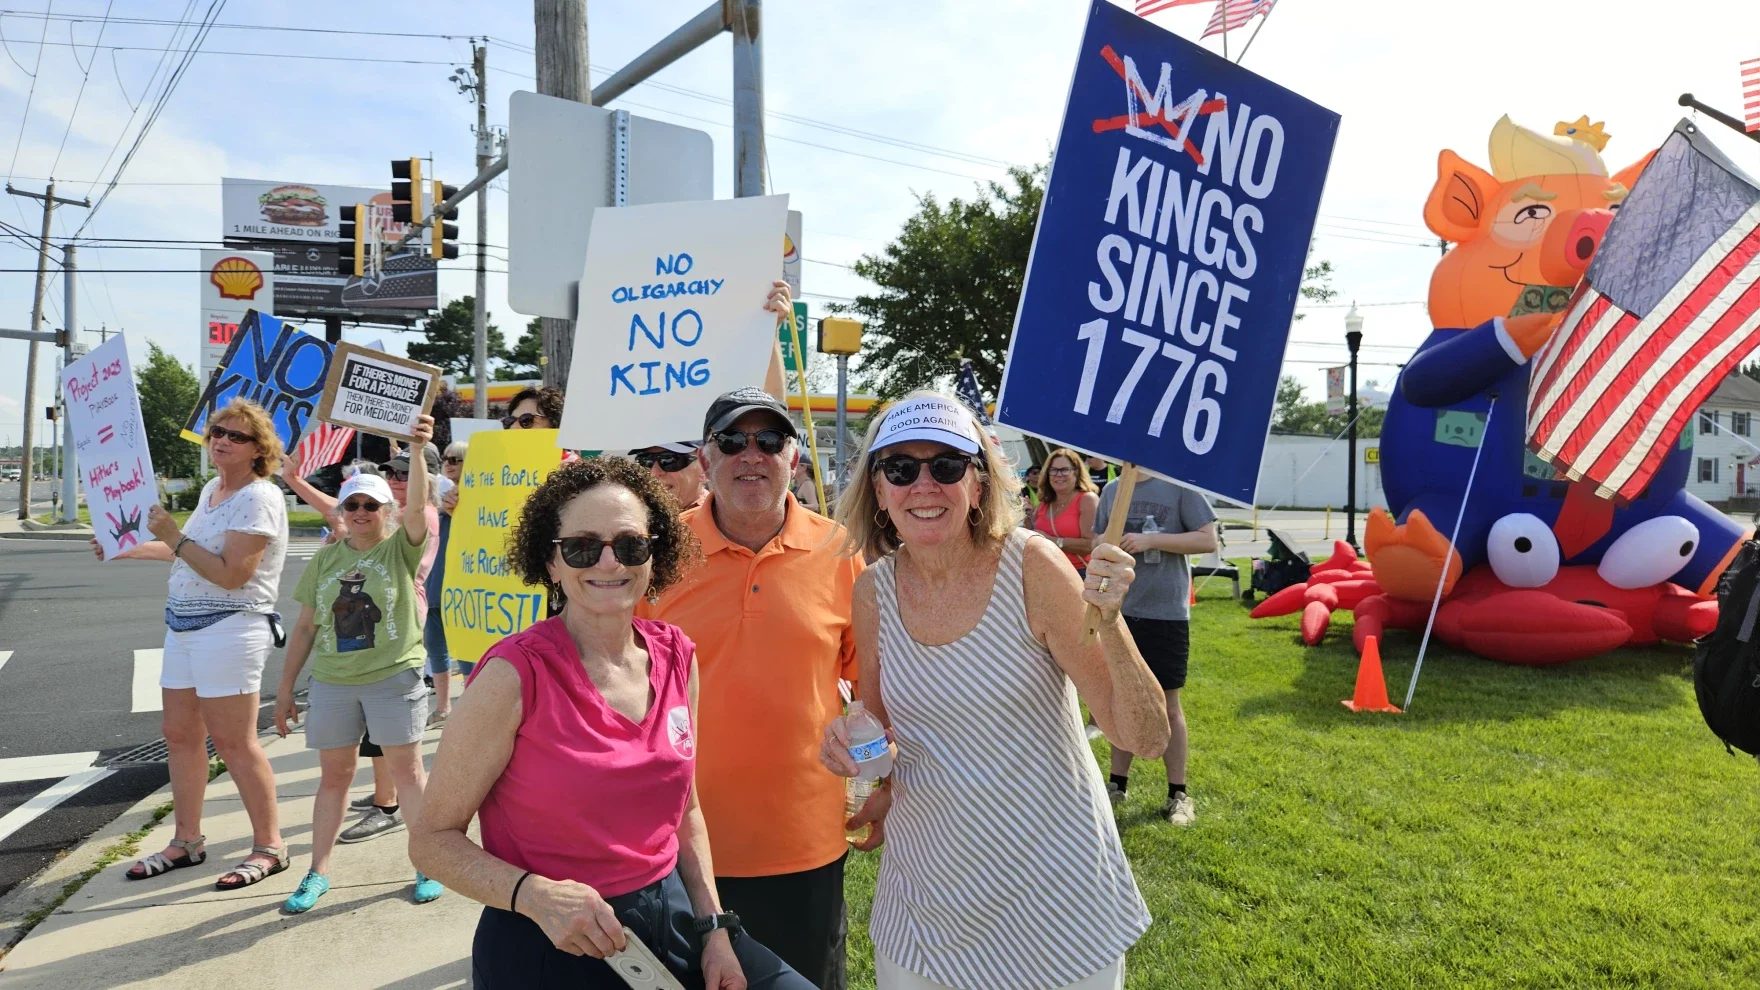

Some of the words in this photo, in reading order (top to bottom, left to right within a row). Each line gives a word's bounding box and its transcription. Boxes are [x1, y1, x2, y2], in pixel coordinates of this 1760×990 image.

[1196, 91, 1285, 200] NO
[1103, 146, 1265, 280] KINGS
[243, 225, 267, 234] MILE
[270, 226, 304, 236] AHEAD
[307, 228, 321, 238] ON
[324, 230, 341, 239] RIG
[655, 252, 694, 276] NO
[611, 278, 725, 304] OLIGARCHY
[1087, 233, 1251, 362] SINCE
[628, 308, 703, 352] NO
[218, 308, 336, 399] NO
[67, 362, 100, 403] Project
[102, 358, 122, 381] 2025
[348, 375, 369, 391] FOR
[369, 380, 379, 394] A
[378, 382, 419, 402] PARADE?
[352, 363, 363, 375] IF
[361, 366, 395, 382] THERE'S
[394, 375, 422, 390] MONEY
[610, 358, 711, 396] KING
[1073, 317, 1228, 455] 1776
[343, 401, 363, 415] FOR
[363, 406, 411, 426] MEDICAID!
[346, 391, 364, 402] THEN
[364, 395, 391, 409] THERE'S
[391, 402, 414, 414] MONEY
[887, 405, 912, 422] MAKE
[914, 402, 960, 416] AMERICA
[890, 417, 921, 432] GOOD
[922, 416, 957, 429] AGAIN!
[463, 470, 475, 489] WE
[479, 471, 495, 487] THE
[501, 464, 539, 488] PEOPLE
[478, 506, 509, 529] HAVE
[461, 551, 475, 575] THE
[477, 548, 511, 577] RIGH
[384, 586, 399, 641] FASCISM
[443, 587, 543, 636] PROTEST!
